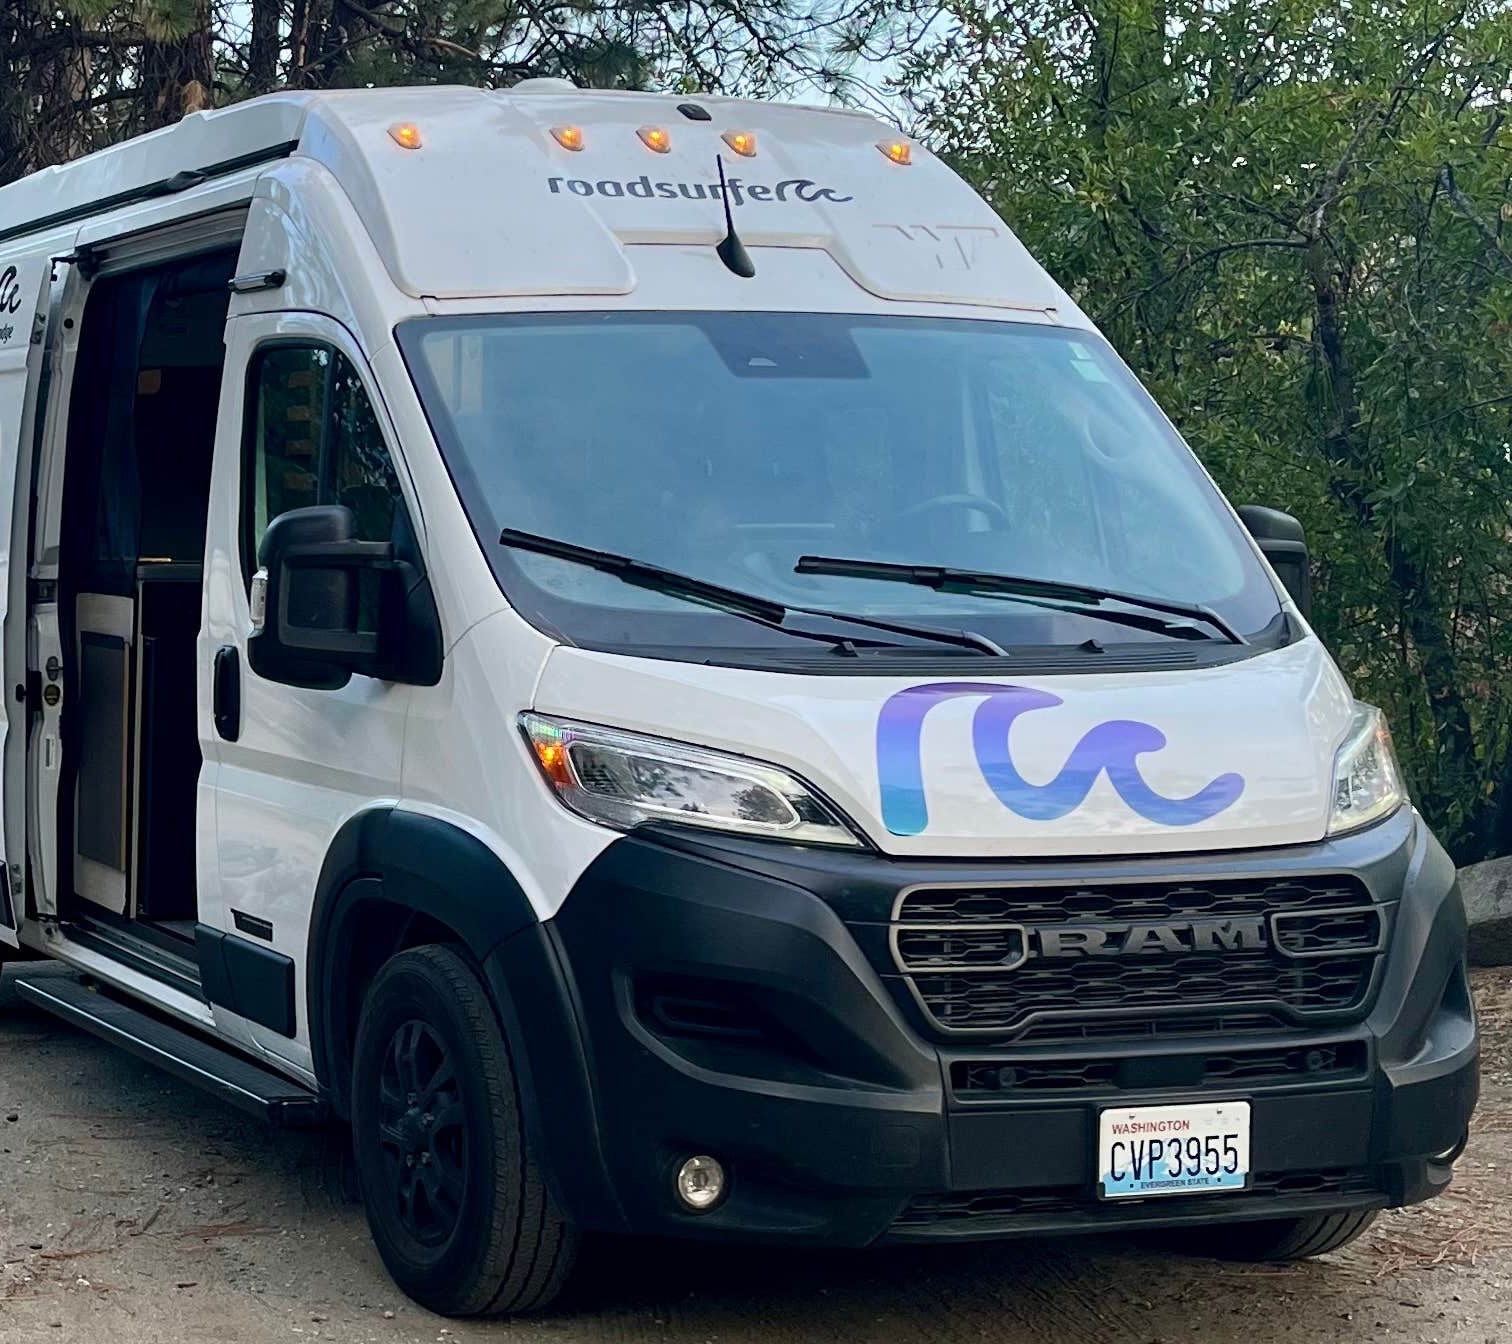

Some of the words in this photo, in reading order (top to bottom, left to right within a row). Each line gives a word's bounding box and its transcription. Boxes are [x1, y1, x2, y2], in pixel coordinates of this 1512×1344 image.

[547, 175, 853, 206] roadsurfer
[1039, 920, 1274, 958] RAM
[1111, 1119, 1191, 1135] WASHINGTON
[1110, 1133, 1239, 1182] CVP3955
[1140, 1179, 1186, 1190] EVERGREEN
[1187, 1177, 1210, 1186] STATE
